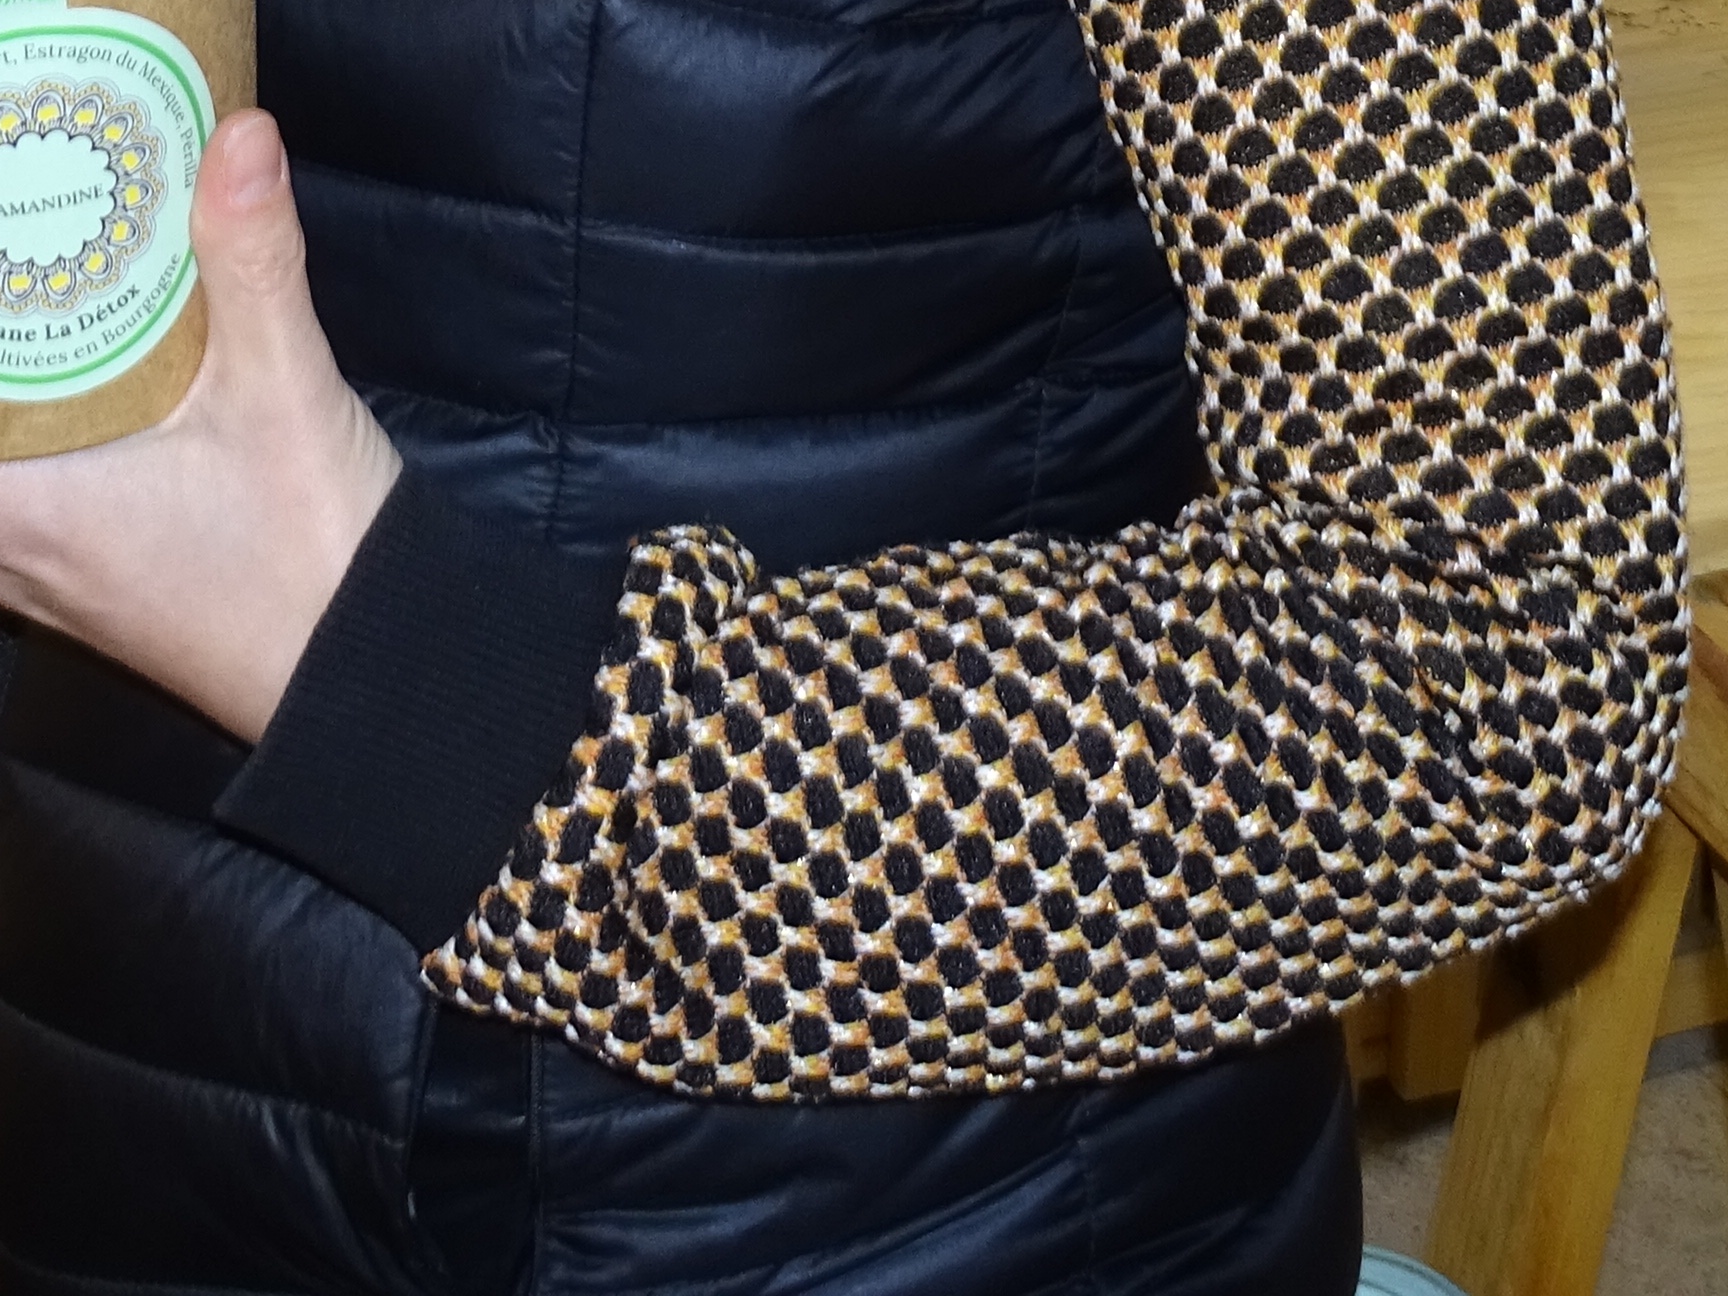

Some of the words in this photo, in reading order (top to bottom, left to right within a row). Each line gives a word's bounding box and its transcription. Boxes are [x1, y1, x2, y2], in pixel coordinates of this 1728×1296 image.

[23, 42, 114, 65] Estragon
[115, 51, 139, 71] du
[137, 63, 186, 132] Mexique,
[181, 126, 198, 190] Périlla
[44, 322, 73, 342] La
[78, 283, 144, 333] Détox
[74, 340, 99, 360] en
[102, 252, 182, 346] Bourgogne
